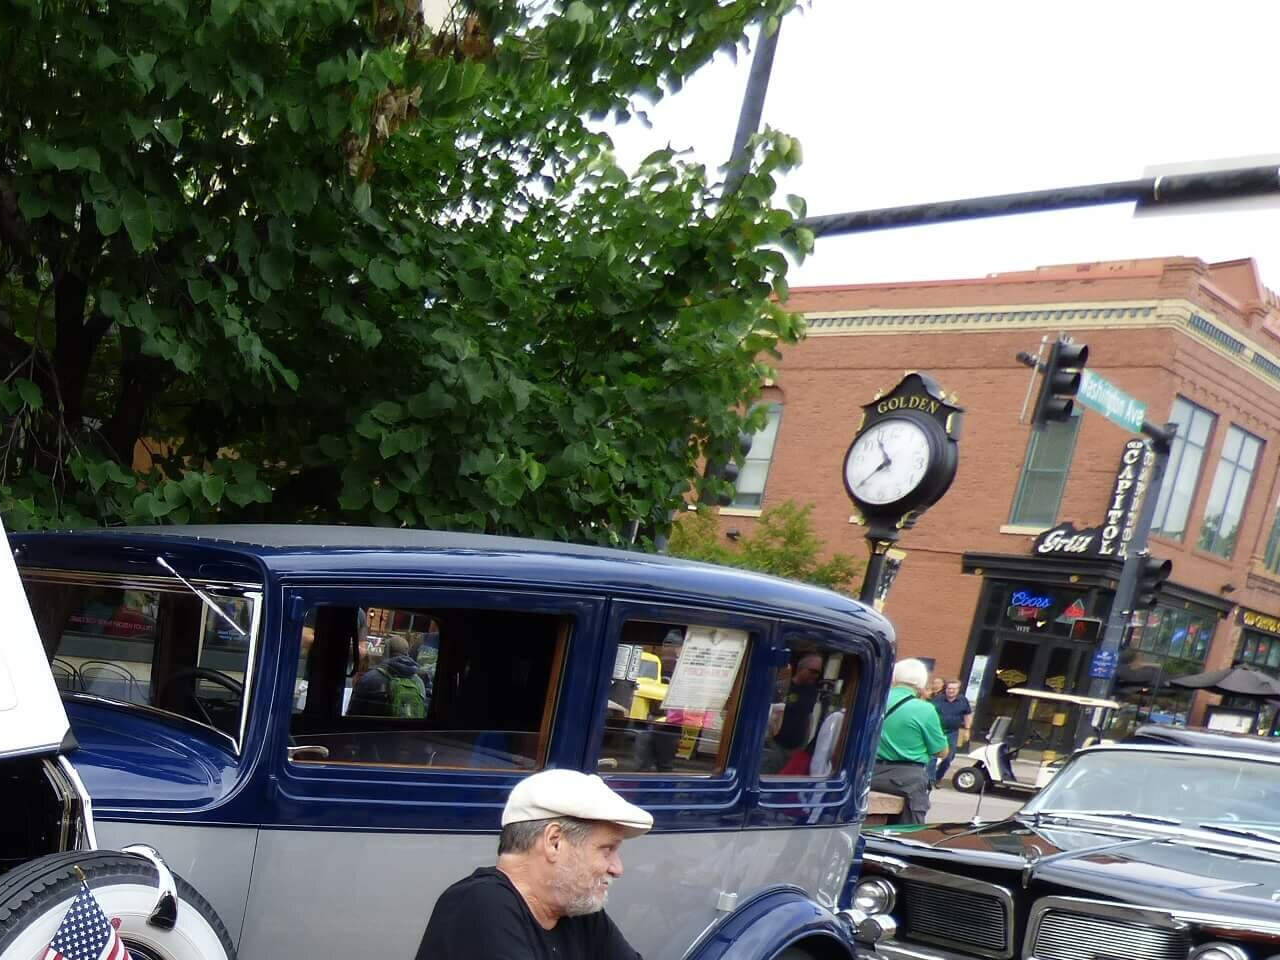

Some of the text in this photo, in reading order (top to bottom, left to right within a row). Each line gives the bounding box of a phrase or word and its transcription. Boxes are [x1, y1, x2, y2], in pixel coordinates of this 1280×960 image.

[877, 396, 940, 414] GOLDEN
[1124, 400, 1144, 427] Ave
[1098, 449, 1140, 555] CAPITOL
[1038, 530, 1093, 553] Grill
[1011, 591, 1051, 608] Coors
